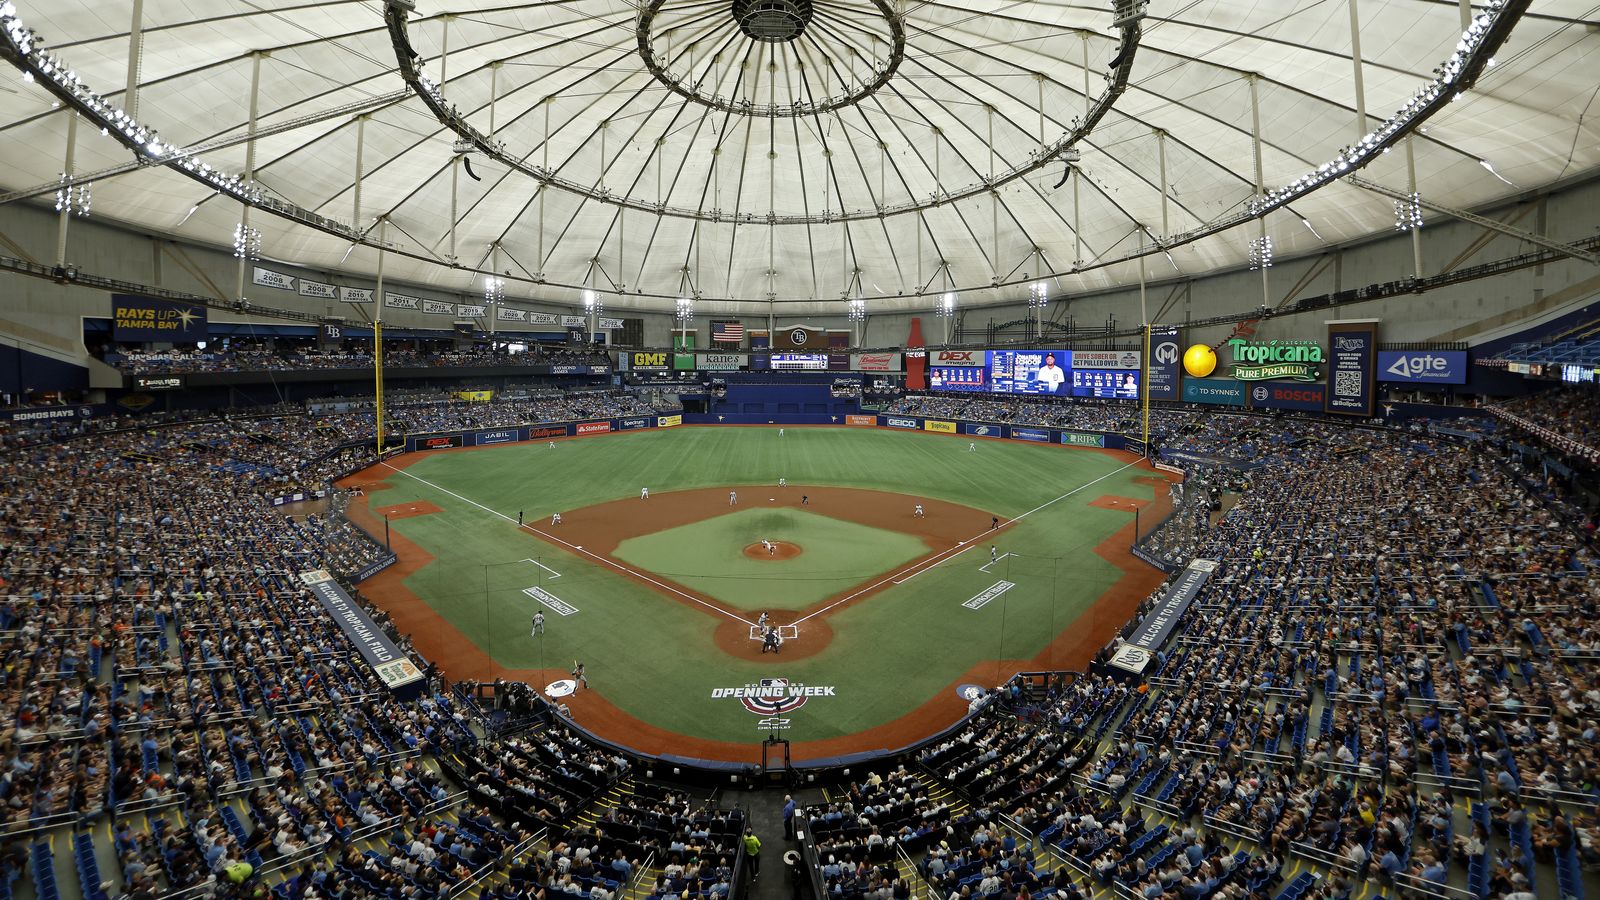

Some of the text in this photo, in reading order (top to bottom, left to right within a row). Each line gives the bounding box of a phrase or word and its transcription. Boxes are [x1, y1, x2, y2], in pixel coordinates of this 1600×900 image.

[257, 279, 288, 288] CHAMPIONS
[264, 275, 283, 283] 2008
[117, 308, 176, 320] RAYS UP
[117, 320, 154, 328] TAMPA
[1228, 338, 1321, 364] Tropicana
[634, 353, 667, 365] GMF
[706, 354, 740, 362] kanes
[938, 352, 973, 361] DEX
[1410, 355, 1447, 369] gte
[1236, 366, 1308, 378] PURE PREMIUM
[1274, 390, 1322, 402] BOSCH
[14, 412, 48, 420] SOMOS
[888, 419, 915, 427] GEICO
[427, 437, 449, 446] DEX
[1077, 435, 1096, 444] RIPA
[1137, 616, 1168, 646] WELCOME
[1161, 608, 1174, 617] TO
[1168, 580, 1194, 608] TROPICANA
[1188, 571, 1202, 584] FIELD
[318, 582, 392, 662] WELCOME TO TROPICANA FIELD
[712, 686, 835, 698] OPENING WEEK
